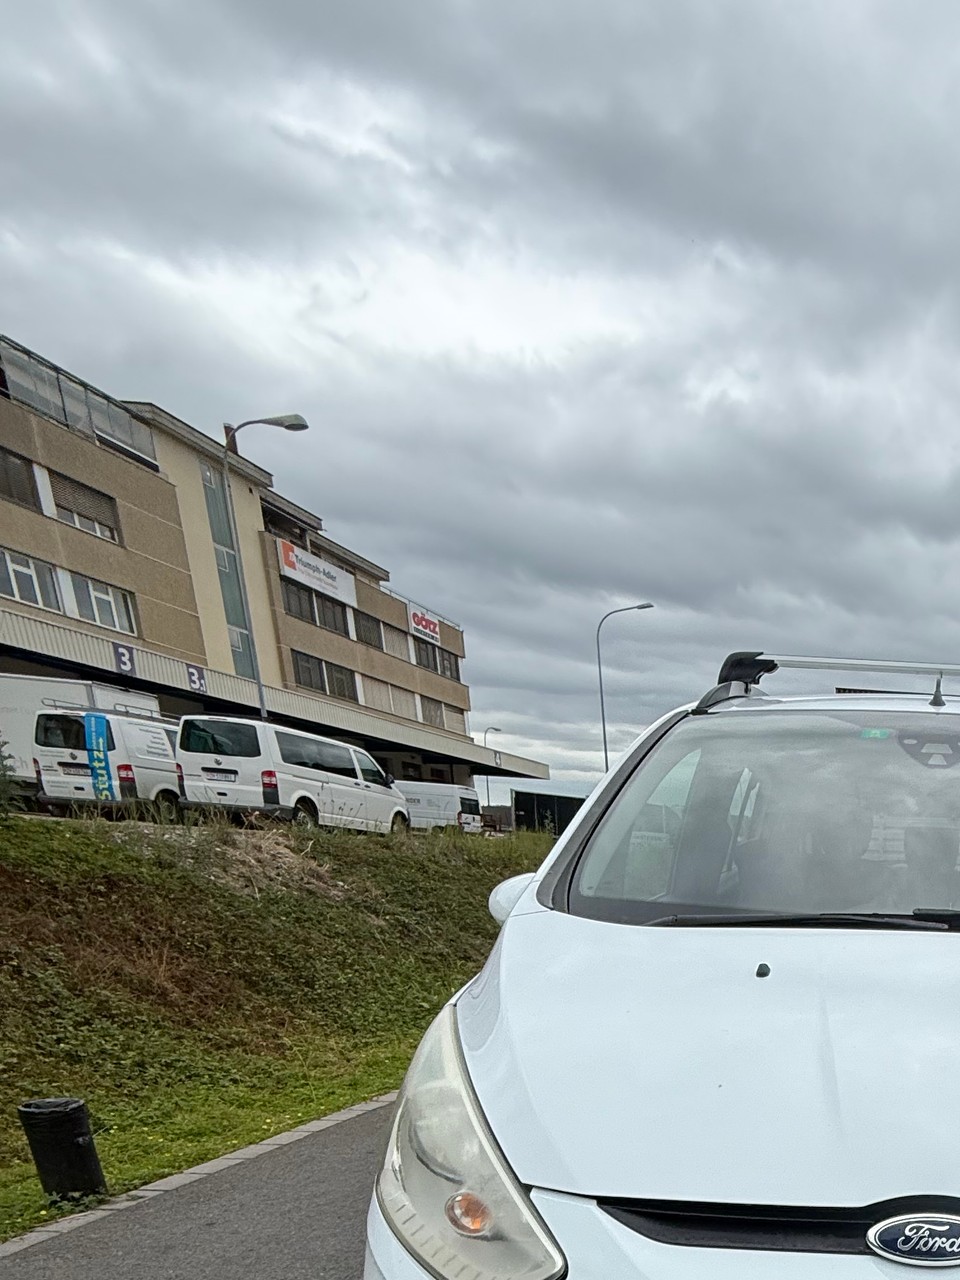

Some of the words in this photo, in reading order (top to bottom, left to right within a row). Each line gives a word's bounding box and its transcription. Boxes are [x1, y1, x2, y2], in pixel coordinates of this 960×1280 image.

[294, 553, 337, 582] Triumph-Adler
[118, 647, 132, 671] 3
[92, 750, 112, 801] Stutz
